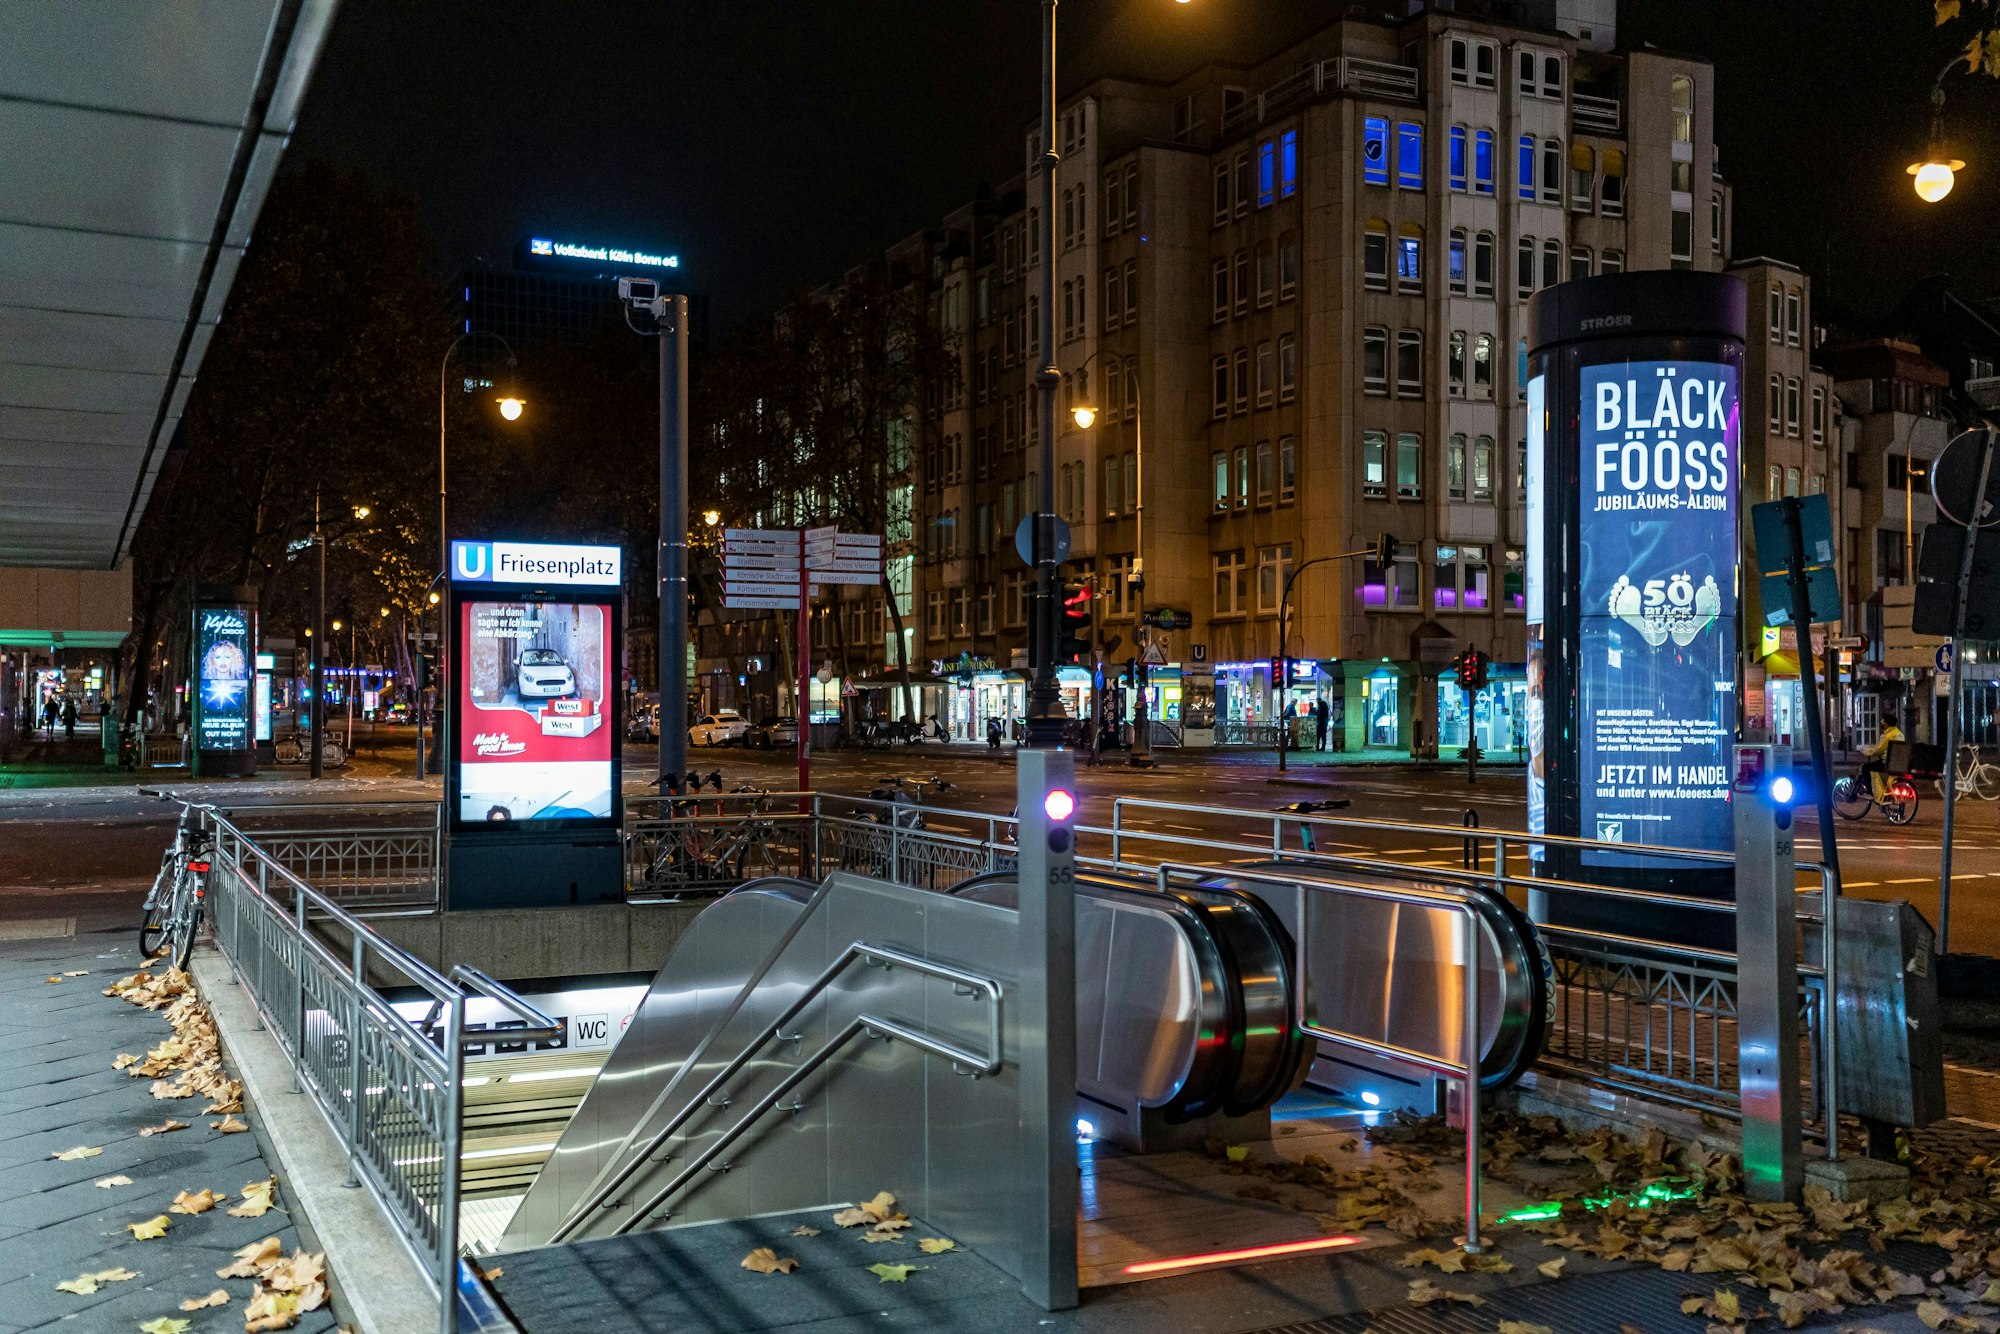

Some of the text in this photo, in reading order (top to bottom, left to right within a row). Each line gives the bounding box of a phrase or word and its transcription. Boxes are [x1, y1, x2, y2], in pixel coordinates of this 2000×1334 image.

[554, 243, 678, 268] Volksbank Köln Bonn eG
[1580, 314, 1632, 331] STRÖER
[1596, 367, 1728, 431] BLÄCK
[1596, 430, 1728, 492] FÖÖSS
[1594, 492, 1727, 511] JUBILÄUMS-ALBUM
[735, 531, 753, 539] Rhein
[737, 543, 785, 552] Hauptbahnhof
[458, 545, 486, 578] U
[501, 553, 614, 578] Friesenplatz
[736, 558, 783, 566] Stadtmuseum
[854, 562, 875, 570] Viertel
[736, 571, 798, 580] Römische Stadtmauer
[820, 574, 858, 583] Friesenplatz
[736, 584, 776, 593] Römerturm
[736, 599, 781, 607] Friesenviertel
[490, 607, 505, 617] und
[506, 608, 525, 617] dann
[1644, 604, 1692, 618] BLÄCK
[204, 614, 243, 633] Kylie
[478, 619, 499, 628] sagte
[521, 618, 543, 627] kenne
[1643, 617, 1695, 633] FÖÖSS
[478, 629, 493, 637] eine
[1194, 646, 1204, 659] U
[1795, 684, 1803, 728] COPY
[551, 721, 573, 729] West
[473, 733, 500, 745] Made
[478, 741, 526, 755] good times
[1597, 765, 1729, 785] JETZT IM HANDEL
[1597, 786, 1729, 801] und unter www.foeoess.shop
[1776, 841, 1791, 856] 56
[1049, 867, 1071, 885] 55
[578, 1020, 606, 1040] WC
